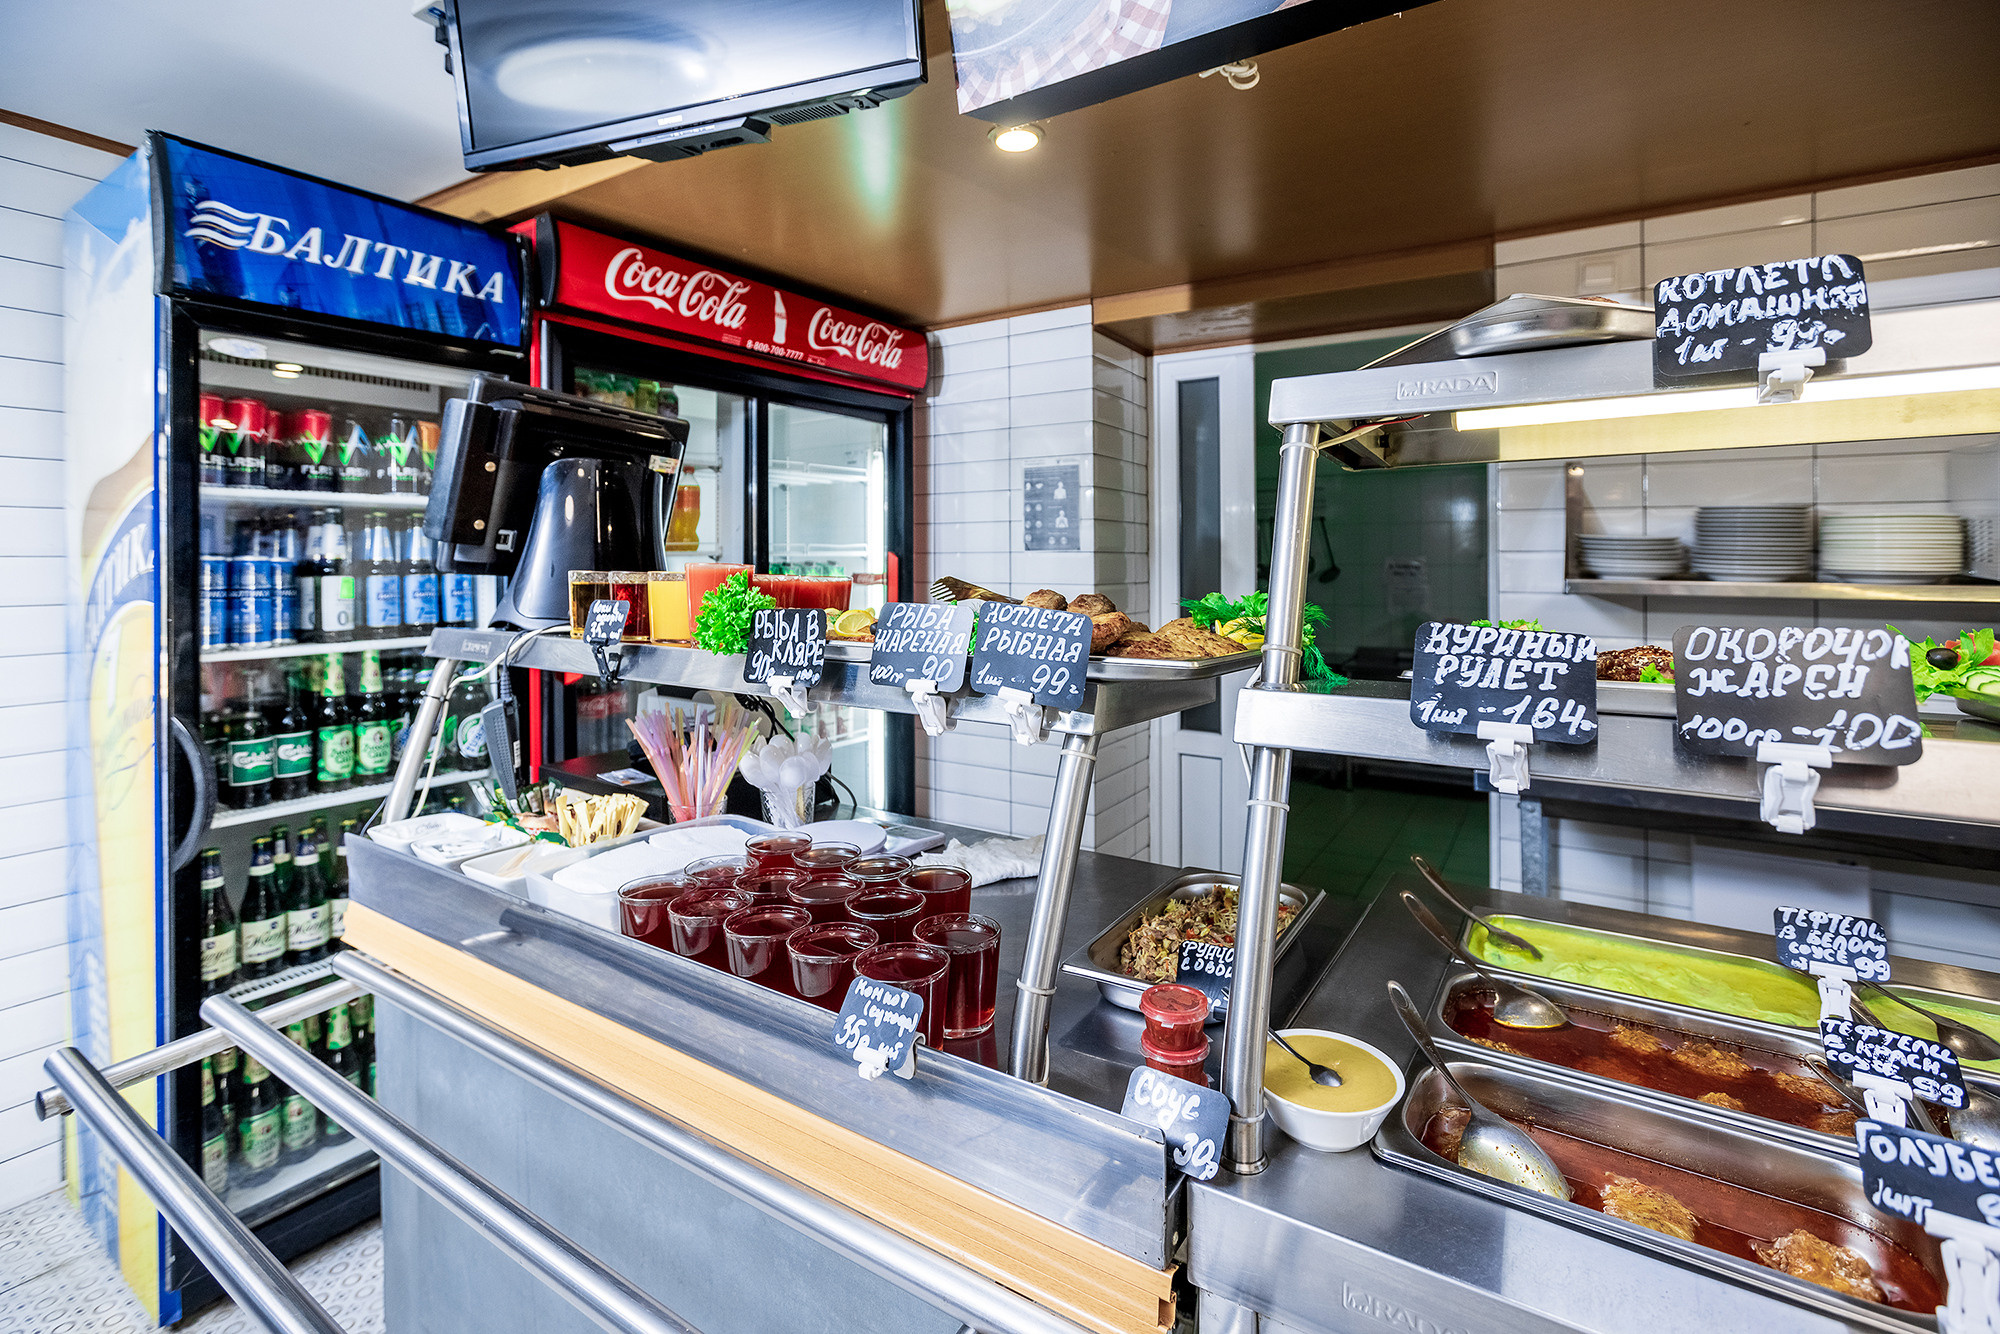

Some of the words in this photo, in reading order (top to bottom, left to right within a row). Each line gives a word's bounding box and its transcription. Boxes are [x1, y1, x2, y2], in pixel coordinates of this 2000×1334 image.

[245, 212, 504, 303] БАЛТИКА
[605, 247, 751, 330] Coca-Cola
[746, 339, 804, 360] 8-800-700-7777
[808, 307, 903, 369] Coca-Cola
[754, 609, 800, 643] РЫБА
[806, 609, 820, 642] В
[886, 603, 957, 630] РЫБА
[770, 639, 826, 667] КЛЯРЕ
[873, 628, 967, 655] ЖАРЕНАЯ
[981, 627, 1083, 663] РЫБНАЯ
[1424, 622, 1597, 663] КУРИНЫЙ
[1684, 627, 1910, 670] ОКОРОЧОК
[1434, 655, 1569, 690] РУЛЕТ
[1686, 661, 1870, 700] ЖАРЕН
[1778, 906, 1887, 942] ТЕФТЕЛИ
[1778, 924, 1797, 940] В
[1806, 929, 1886, 959] БЕЛОМ
[1788, 941, 1848, 965] СОУСЕ
[1853, 956, 1891, 982] 99
[1823, 1018, 1957, 1065] ТЕФТЕЛИ
[1855, 1121, 2000, 1188] ГОЛУБЕ
